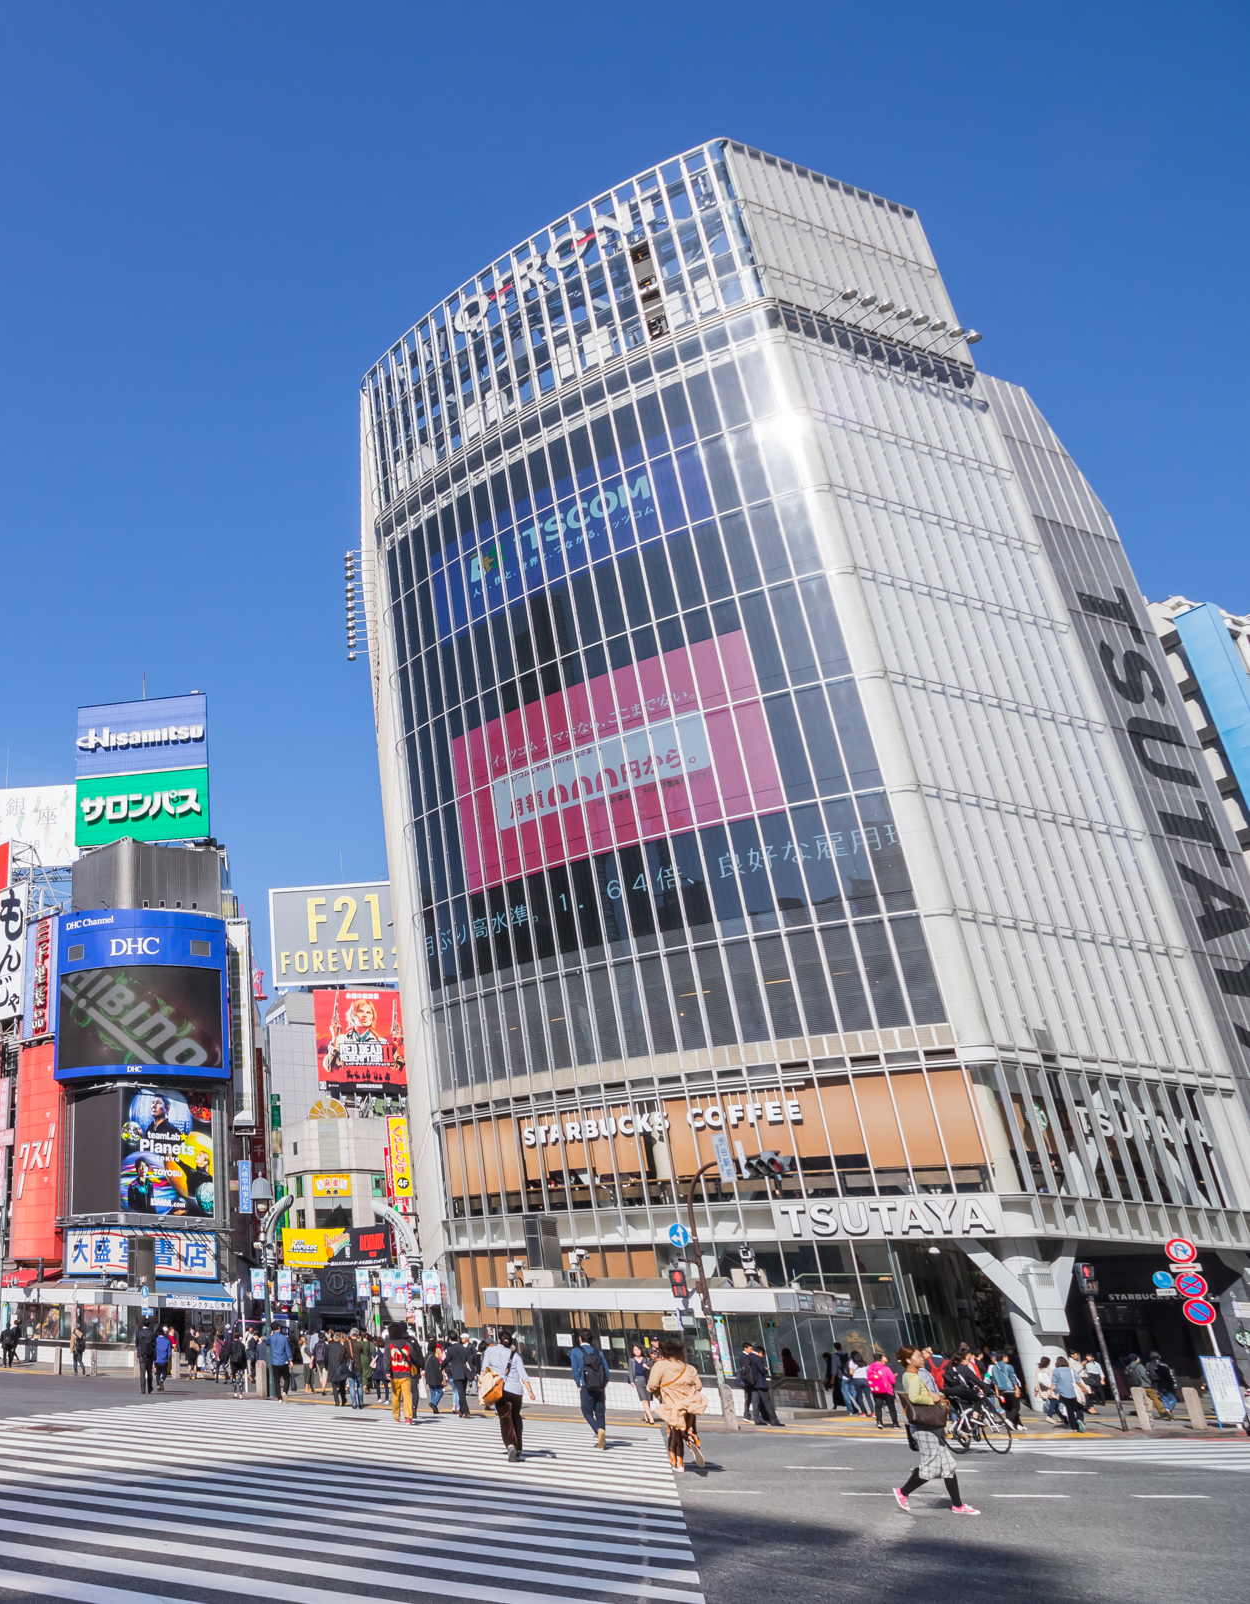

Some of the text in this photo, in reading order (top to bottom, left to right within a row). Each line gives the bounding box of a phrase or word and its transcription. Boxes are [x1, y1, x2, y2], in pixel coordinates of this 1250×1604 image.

[75, 724, 204, 751] Hisamitsu
[80, 788, 201, 822] サロンパス
[1076, 586, 1250, 1050] TSUTA
[66, 915, 114, 931] DHC Channel
[307, 893, 382, 944] F21
[110, 937, 160, 956] DHC
[280, 946, 386, 975] FOREVER
[358, 1044, 383, 1055] DEAD
[523, 1099, 803, 1146] STARBUCKS COFFEE
[1075, 1104, 1214, 1148] TSUTAYA
[147, 1130, 181, 1142] teamLab
[139, 1139, 196, 1157] Planets
[152, 1168, 183, 1178] TOYOSU
[397, 1179, 409, 1187] 4F
[150, 1198, 186, 1209] DMM.com
[779, 1199, 996, 1237] TSUTAYA
[1108, 1293, 1170, 1301] STARBUCKS
